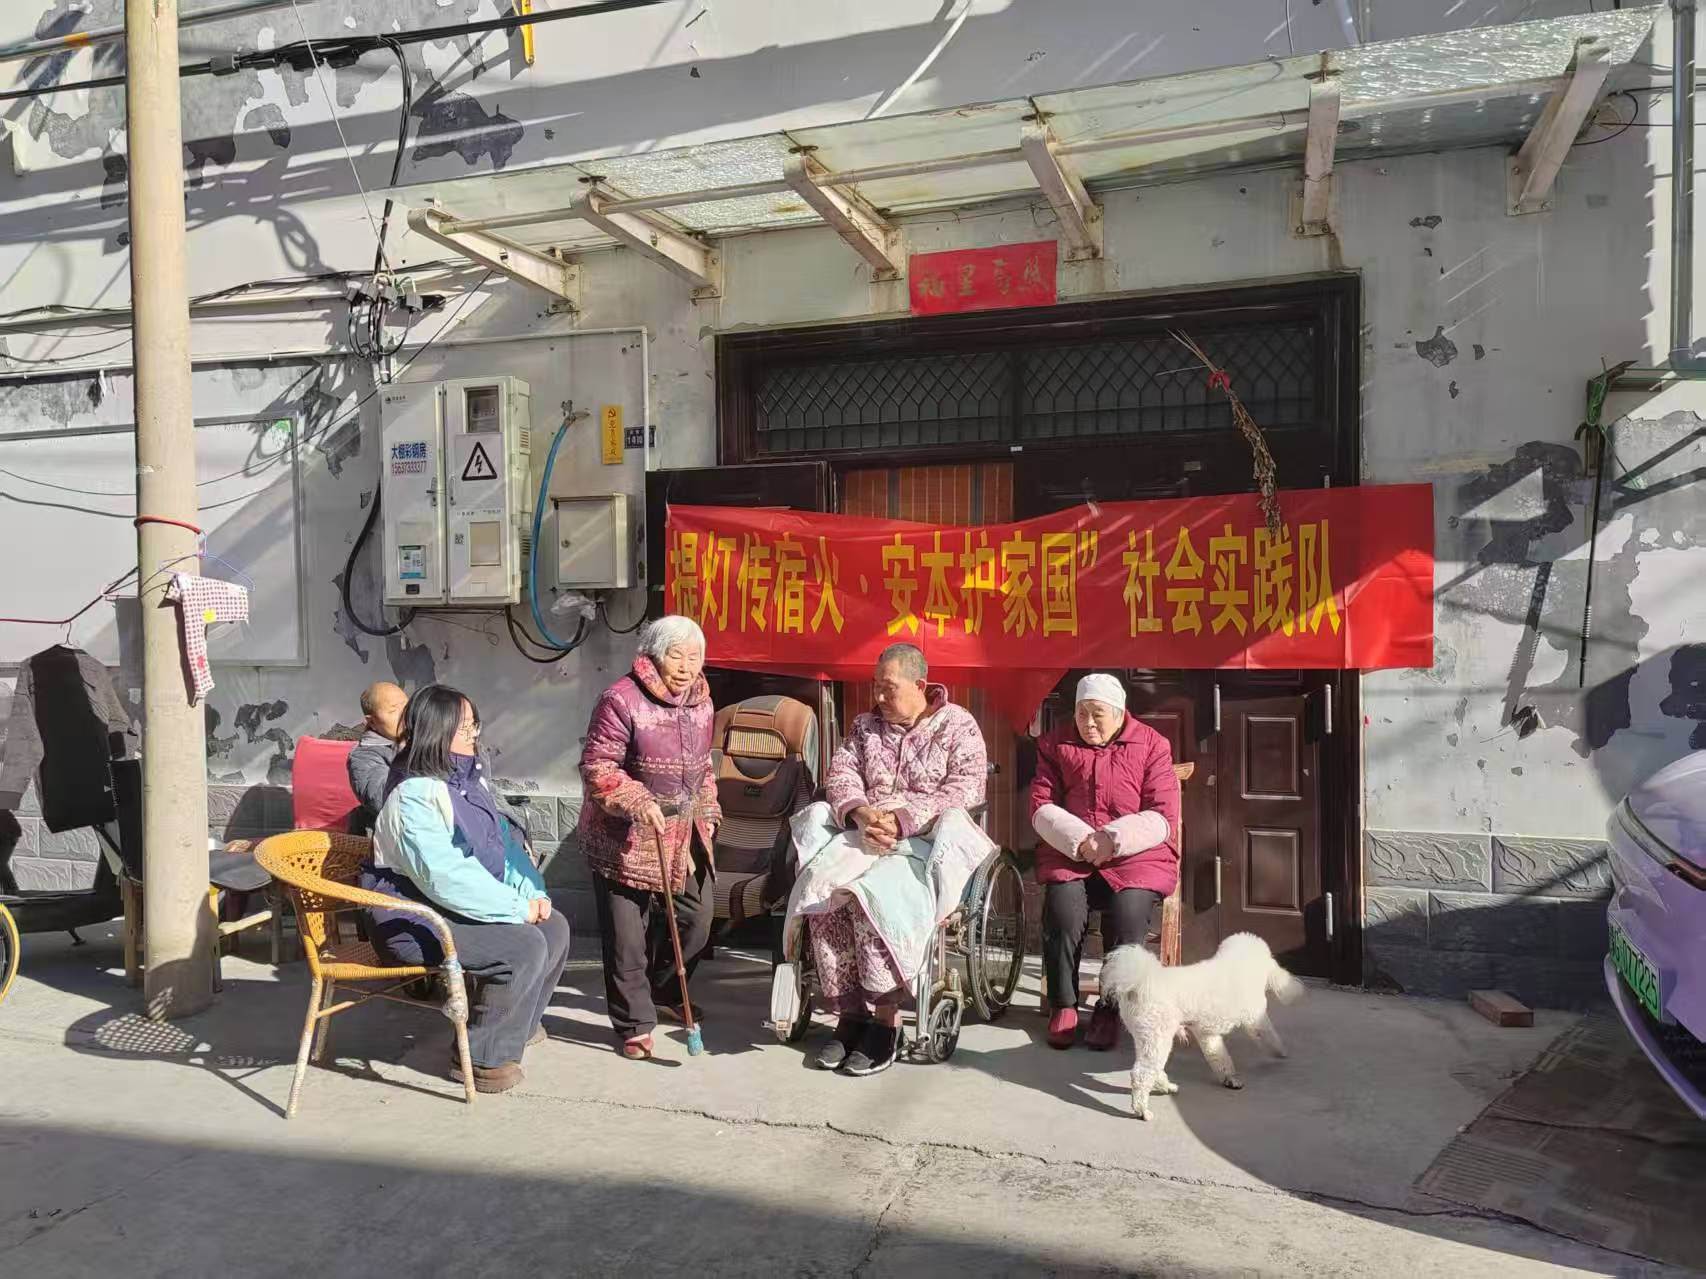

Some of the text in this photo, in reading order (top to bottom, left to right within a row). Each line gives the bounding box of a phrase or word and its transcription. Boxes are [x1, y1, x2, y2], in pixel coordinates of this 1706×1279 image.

[1122, 518, 1342, 638] 社会实践队
